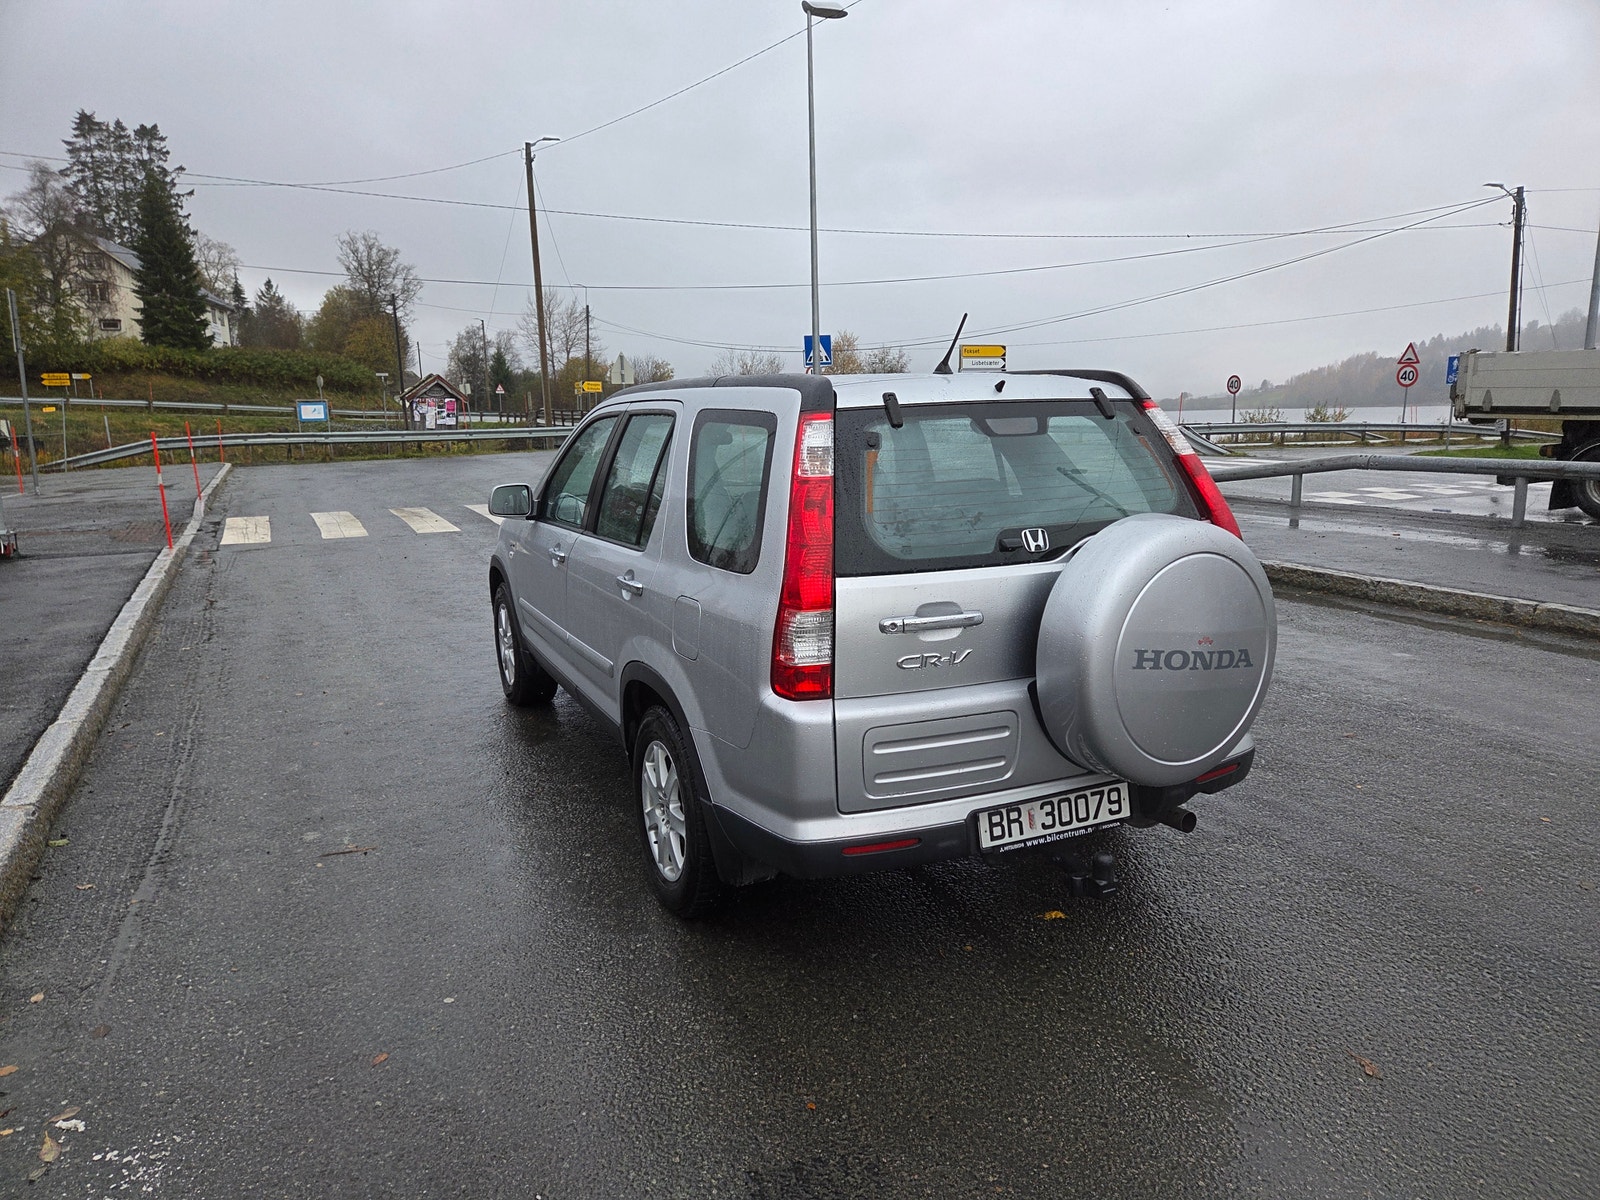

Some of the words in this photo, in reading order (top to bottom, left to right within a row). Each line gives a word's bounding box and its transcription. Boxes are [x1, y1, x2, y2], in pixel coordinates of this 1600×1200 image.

[1229, 379, 1239, 389] 40
[1400, 370, 1415, 381] 40
[896, 648, 973, 670] CR-V
[1132, 648, 1254, 671] HONDA
[987, 806, 1025, 842] BR
[1039, 787, 1123, 831] 30079
